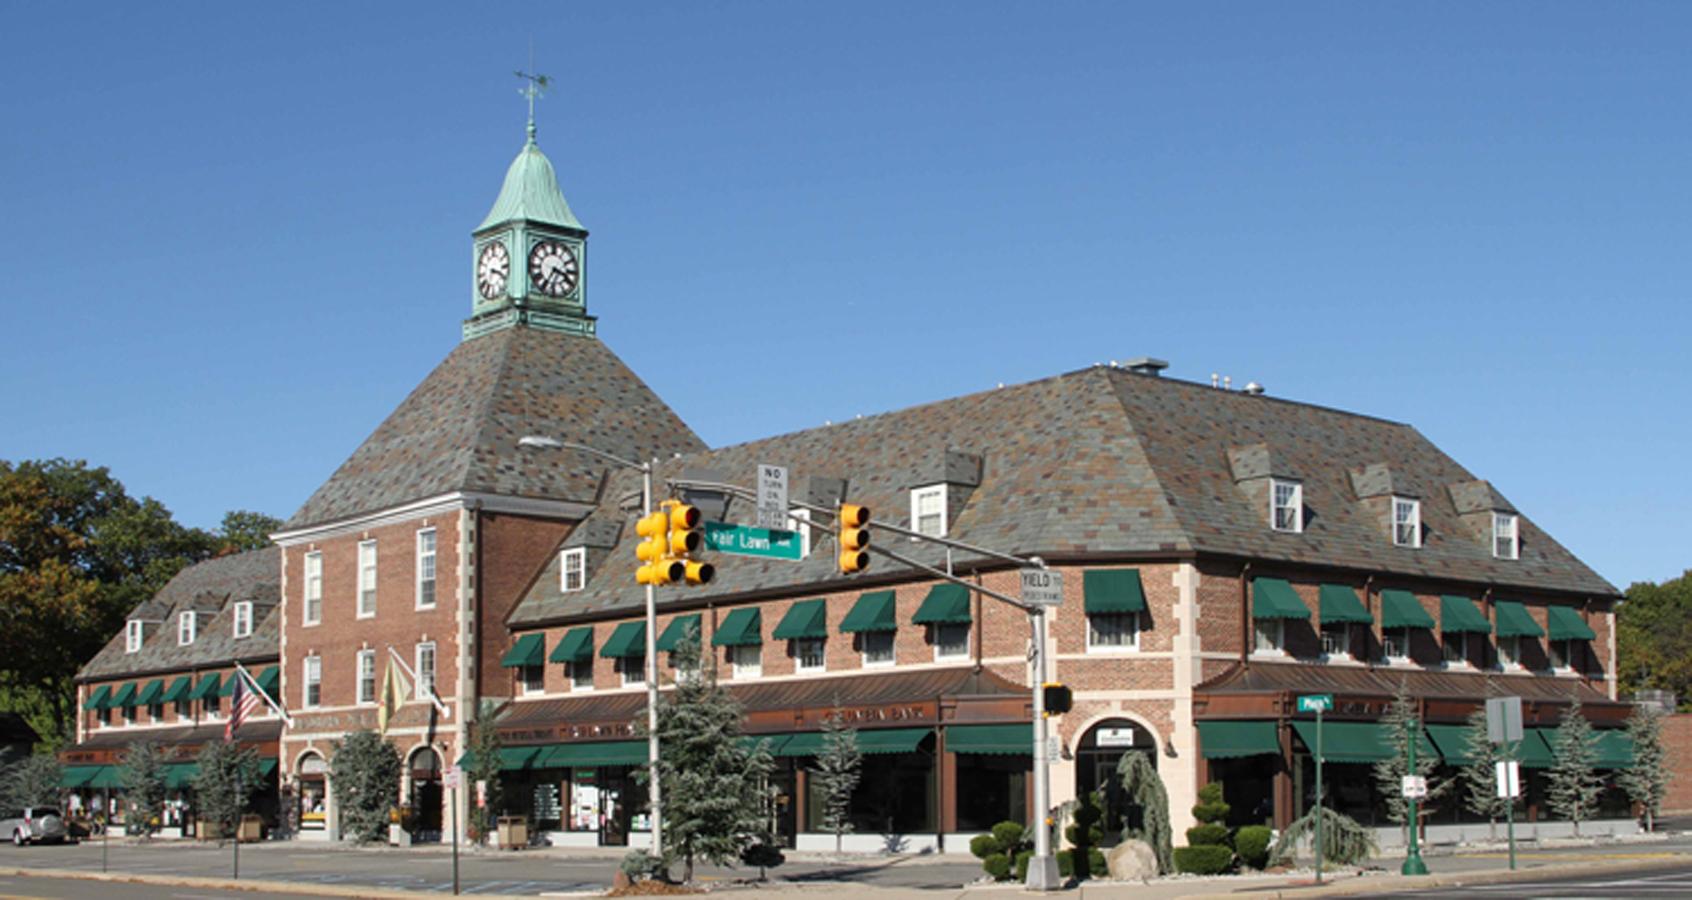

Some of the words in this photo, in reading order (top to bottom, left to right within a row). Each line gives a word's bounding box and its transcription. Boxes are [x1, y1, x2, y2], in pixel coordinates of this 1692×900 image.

[765, 468, 781, 479] NO
[711, 529, 736, 546] Fair
[740, 532, 770, 551] Lawn
[1022, 572, 1050, 588] YIELD
